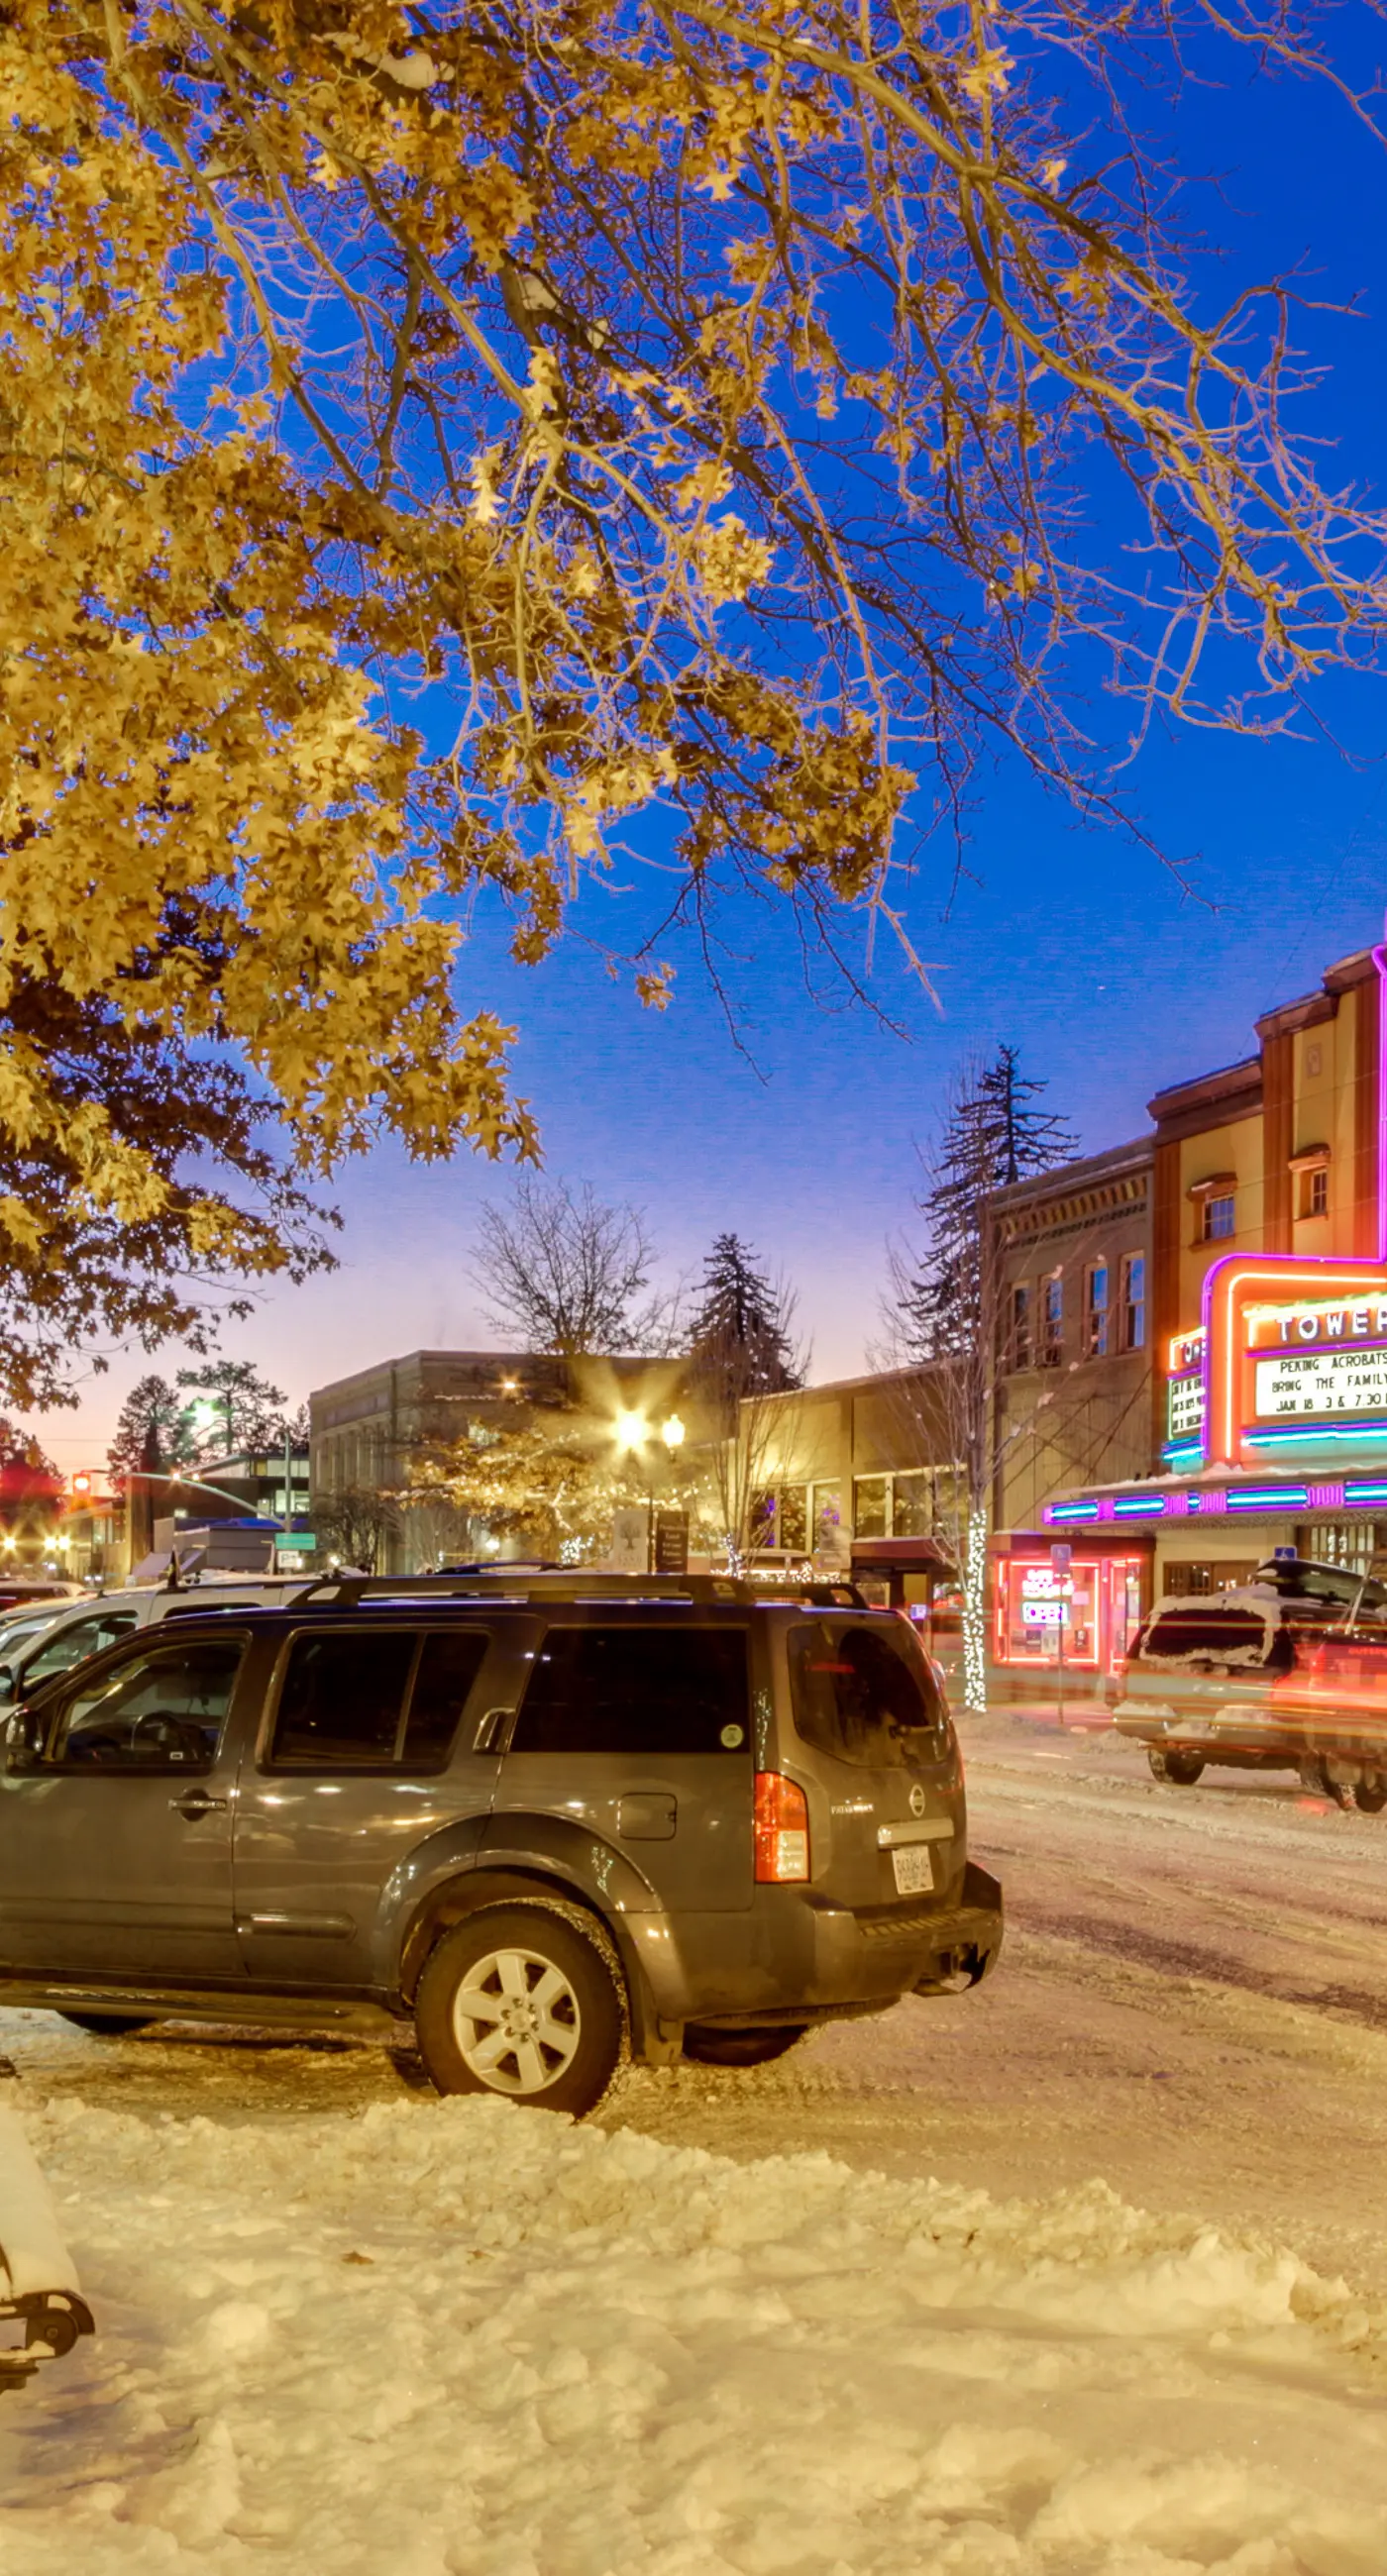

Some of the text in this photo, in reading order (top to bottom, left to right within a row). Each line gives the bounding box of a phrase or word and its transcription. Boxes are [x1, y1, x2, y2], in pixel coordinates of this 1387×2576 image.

[1280, 1358, 1320, 1373] PEKING
[1272, 1379, 1302, 1392] BRING
[1316, 1377, 1334, 1390] THE
[1276, 1399, 1296, 1412] JAN
[1304, 1397, 1314, 1410] 18
[1326, 1396, 1333, 1408] 3
[1337, 1394, 1345, 1407] &
